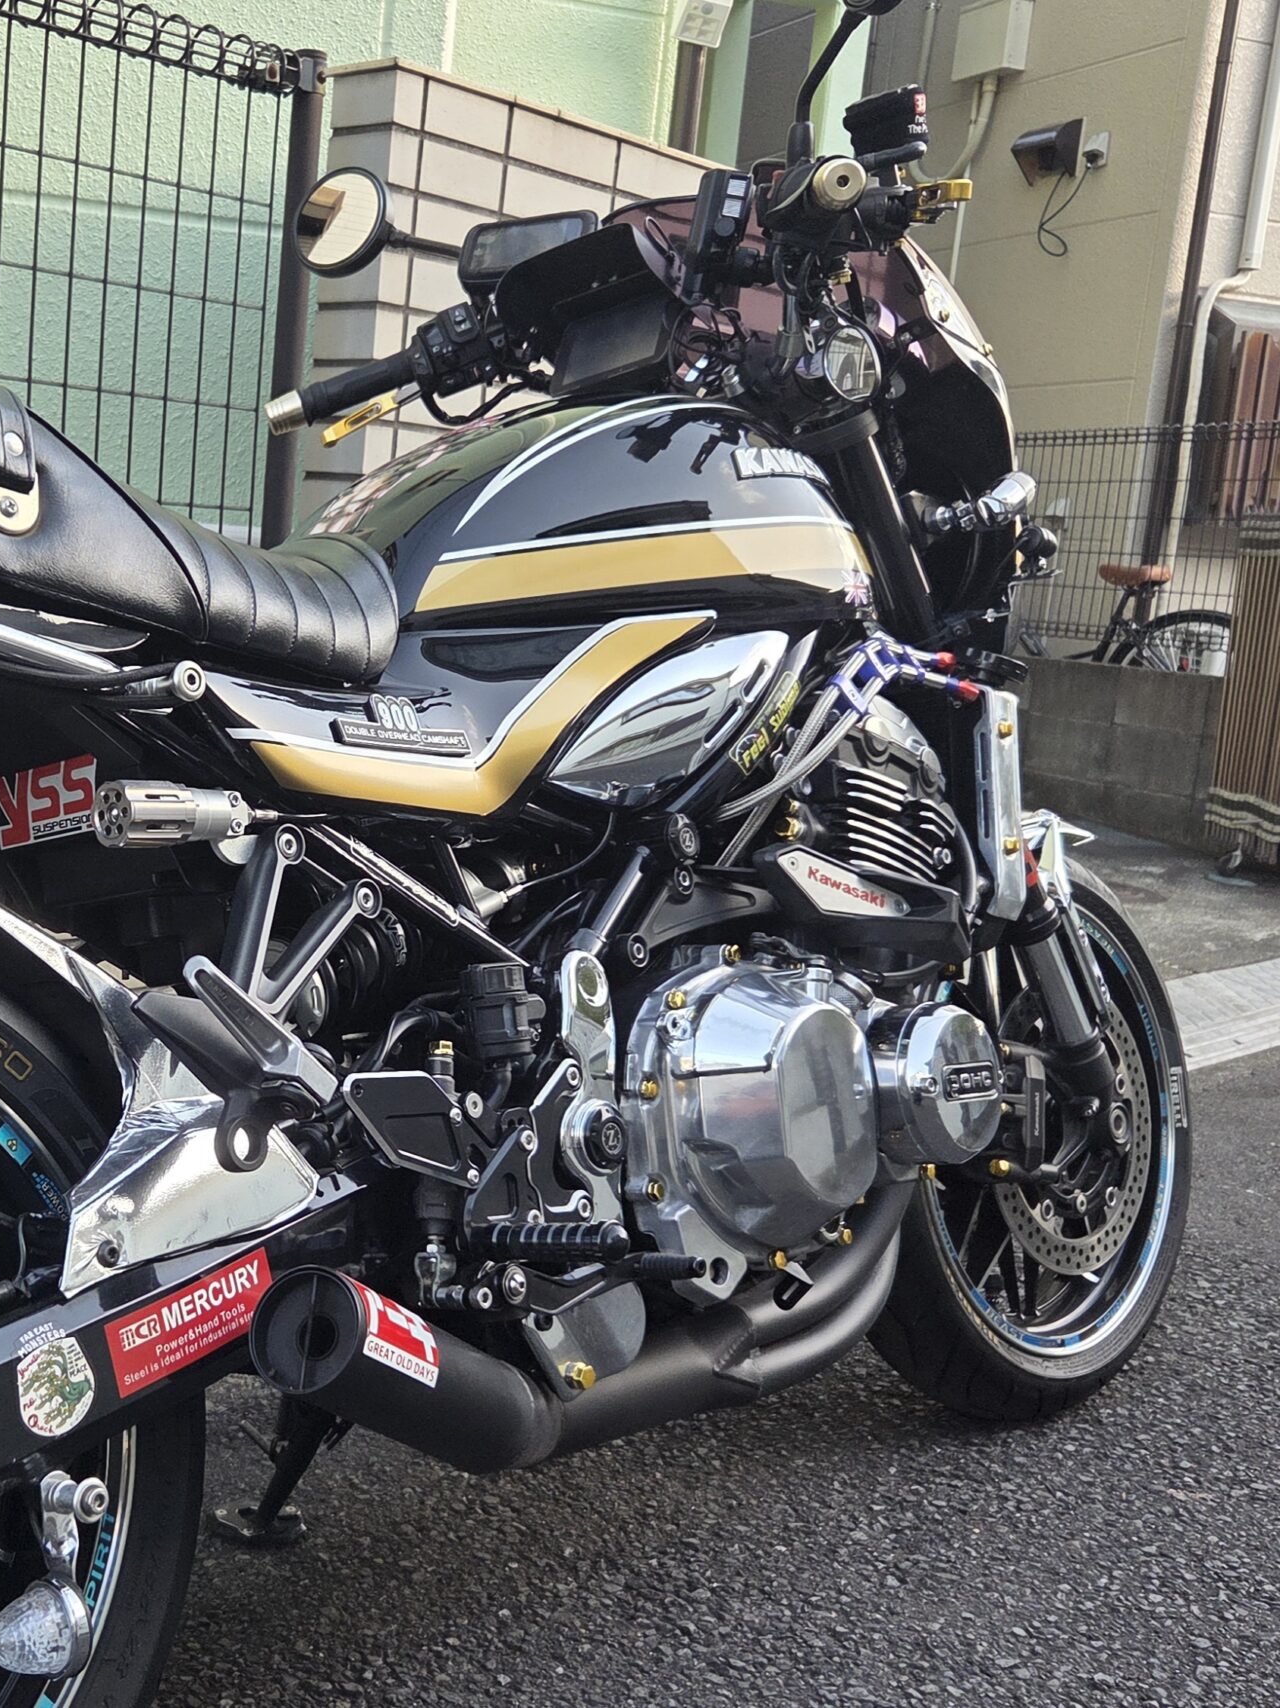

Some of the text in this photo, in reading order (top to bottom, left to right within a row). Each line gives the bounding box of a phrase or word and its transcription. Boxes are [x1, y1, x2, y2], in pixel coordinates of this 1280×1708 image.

[344, 724, 466, 748] DOUBLE OVERHEAD CAMSHAFT
[378, 701, 418, 733] 900
[807, 866, 886, 909] Kawasaki
[161, 1259, 260, 1333] MERCURY
[17, 1328, 67, 1359] MONSTERS
[19, 1321, 55, 1344] FAR EAST
[155, 1302, 246, 1357] Power&Hand Tools
[123, 1366, 149, 1386] Steel
[150, 1361, 159, 1373] is
[161, 1347, 184, 1368] ideal
[185, 1342, 199, 1356] for
[367, 1340, 436, 1382] GREAT OLD DAYS
